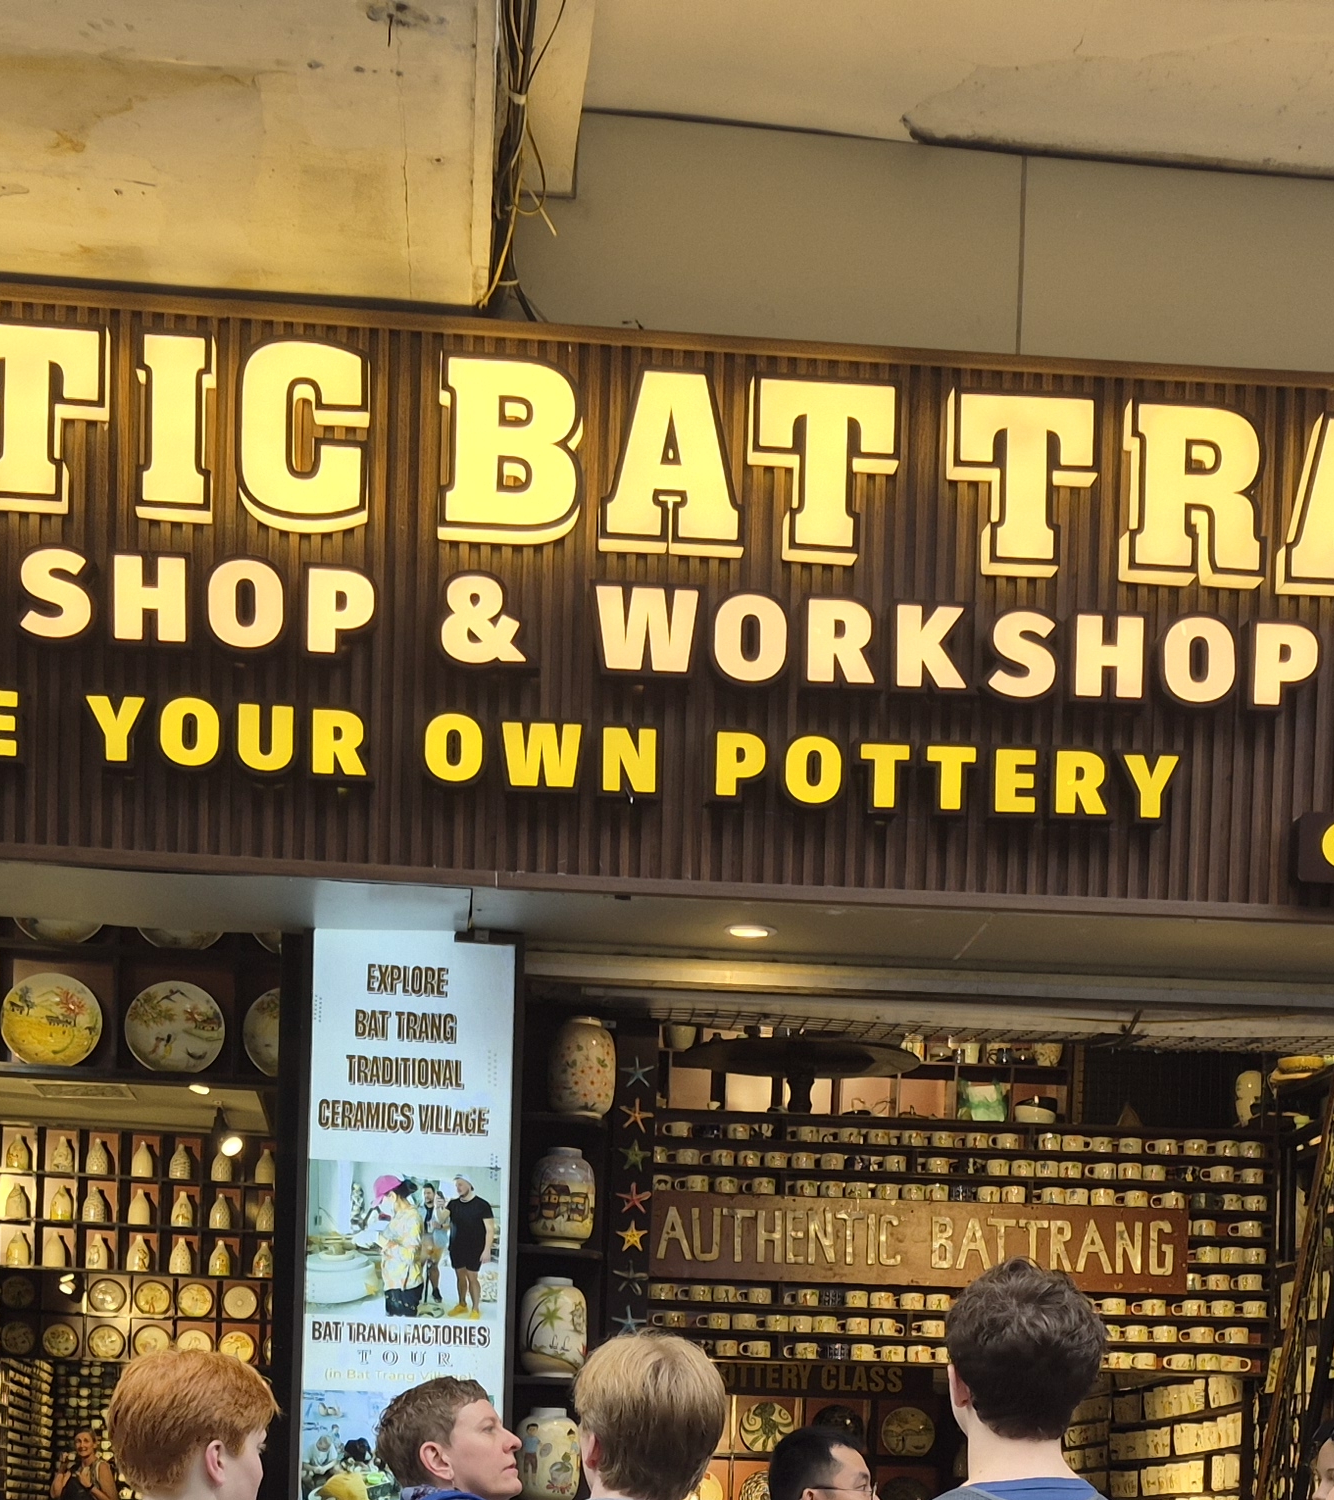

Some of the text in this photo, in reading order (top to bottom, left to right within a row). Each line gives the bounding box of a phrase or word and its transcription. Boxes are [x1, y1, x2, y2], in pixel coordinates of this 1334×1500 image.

[438, 350, 899, 566] BAT
[20, 549, 375, 654] SHOP
[440, 575, 526, 663] &
[596, 586, 1318, 706] WORKSHOP
[87, 695, 366, 777] YOUR
[424, 712, 657, 793] OWN
[716, 731, 1179, 819] POTTERY
[367, 963, 449, 998] EXPLORE
[355, 1009, 457, 1044] BAT TRANG
[346, 1054, 464, 1090] TRADITIONAL
[318, 1099, 489, 1136] CERAMICS VILLAGE
[656, 1206, 1174, 1277] AUTHENTIC BATTRANG
[312, 1321, 490, 1348] BAT TRANG FACTORIES
[347, 1369, 369, 1381] Bat
[376, 1370, 415, 1383] Trang
[357, 1350, 453, 1367] TOUR
[722, 1363, 904, 1393] OTTERY CLASS
